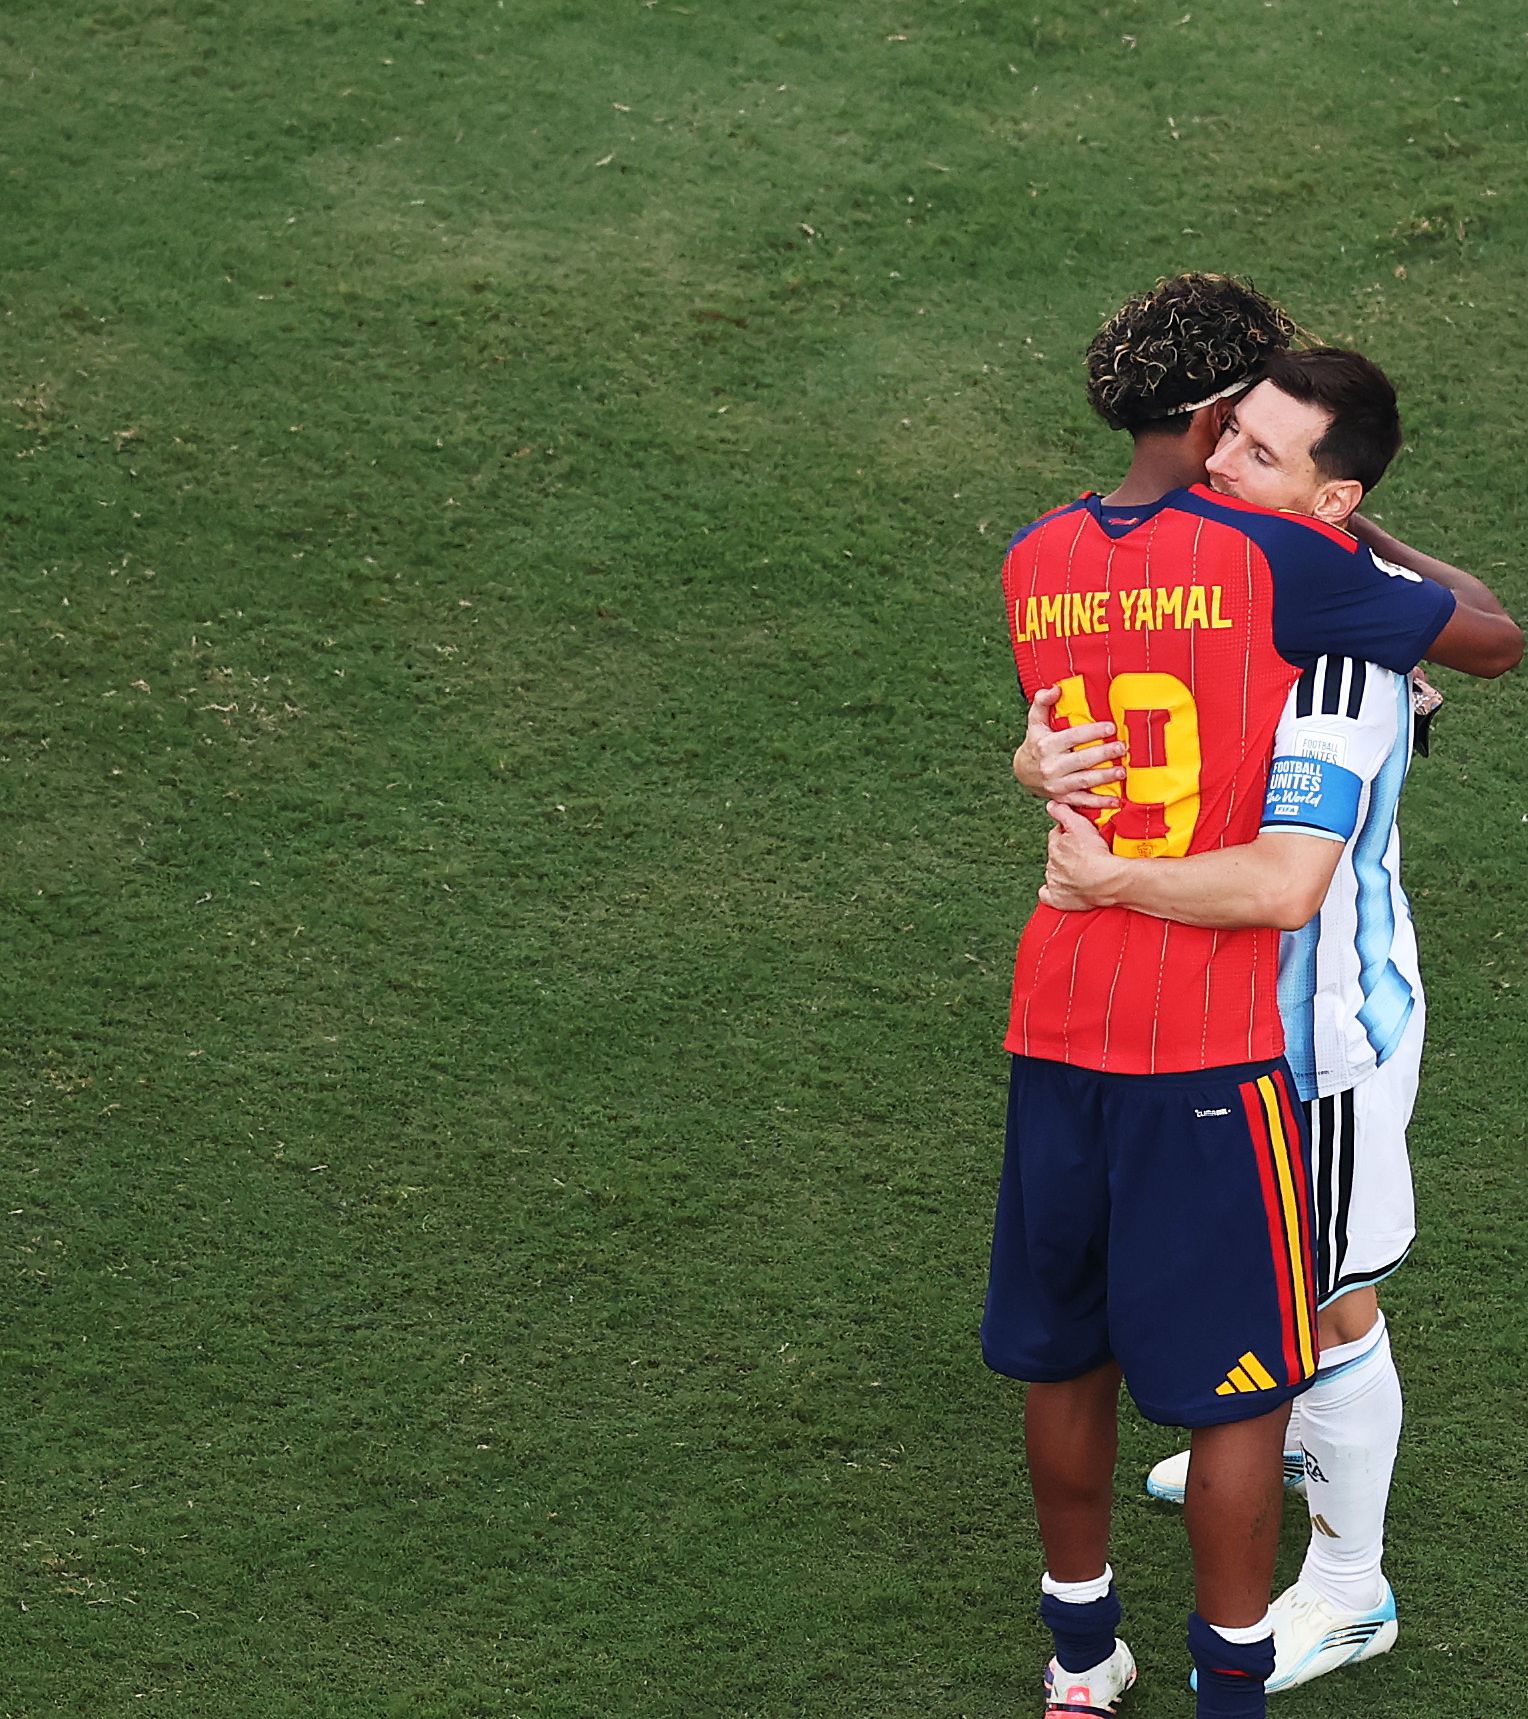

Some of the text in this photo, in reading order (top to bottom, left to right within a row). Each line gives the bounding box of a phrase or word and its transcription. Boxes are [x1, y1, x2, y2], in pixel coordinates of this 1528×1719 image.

[1014, 585, 1233, 643] LAMINE YAMAL
[1303, 738, 1338, 753] FOOTBALL
[1272, 760, 1323, 777] FOOTBALL
[1270, 773, 1322, 792] UNITES
[1266, 789, 1323, 808] the World
[1276, 806, 1297, 814] FIFA
